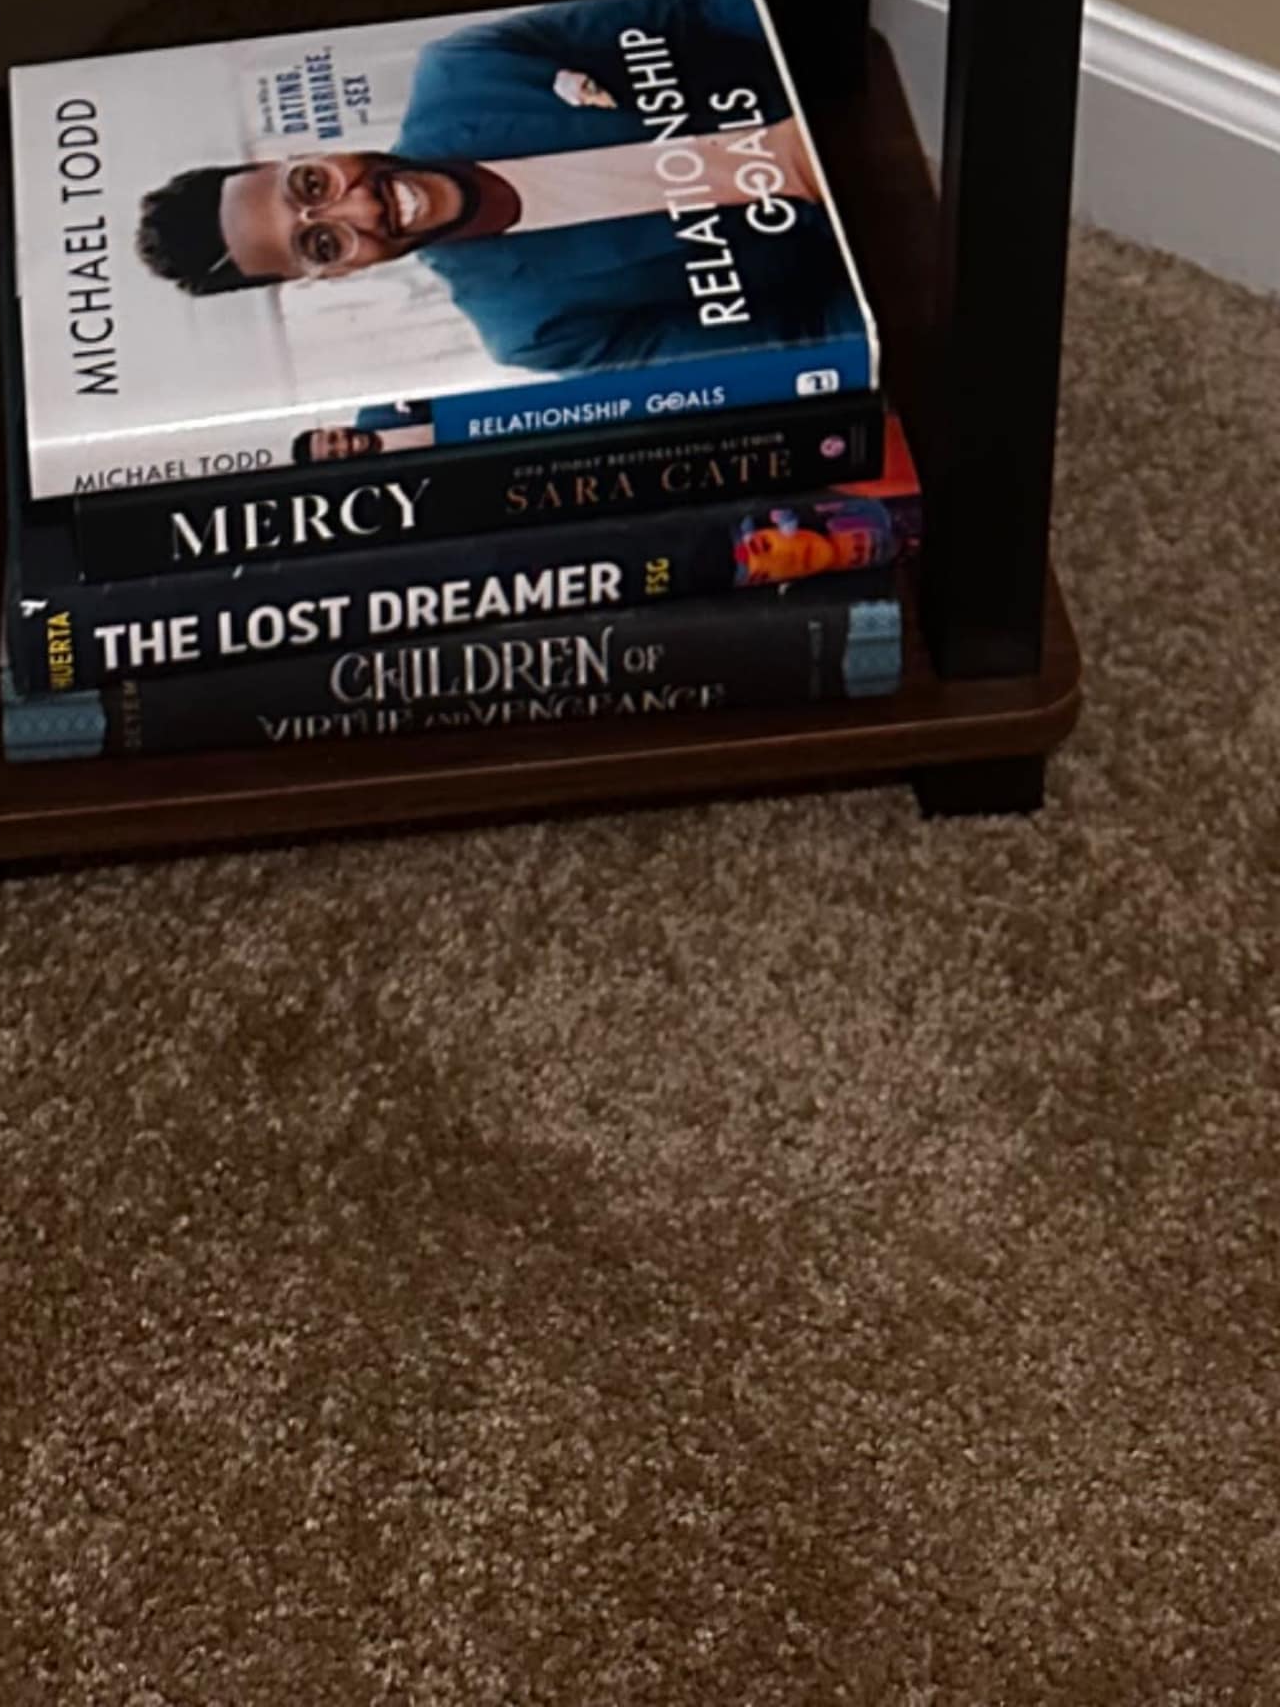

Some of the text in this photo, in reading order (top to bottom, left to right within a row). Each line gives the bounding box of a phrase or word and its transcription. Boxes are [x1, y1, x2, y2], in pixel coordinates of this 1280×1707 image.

[342, 73, 372, 107] SEX
[619, 28, 751, 327] RELATIONSHIP
[709, 88, 797, 234] GOALS
[56, 98, 119, 395] MICHAEL TODD
[467, 387, 726, 438] RELATIONSHIP GOALS
[73, 448, 274, 493] MICHAEL TODD
[505, 449, 793, 515] SARA CATE
[170, 477, 432, 561] MERCY
[645, 557, 670, 595] FSG
[93, 561, 622, 671] THE LOST DREAMER
[330, 625, 666, 703] CHILDREN OF
